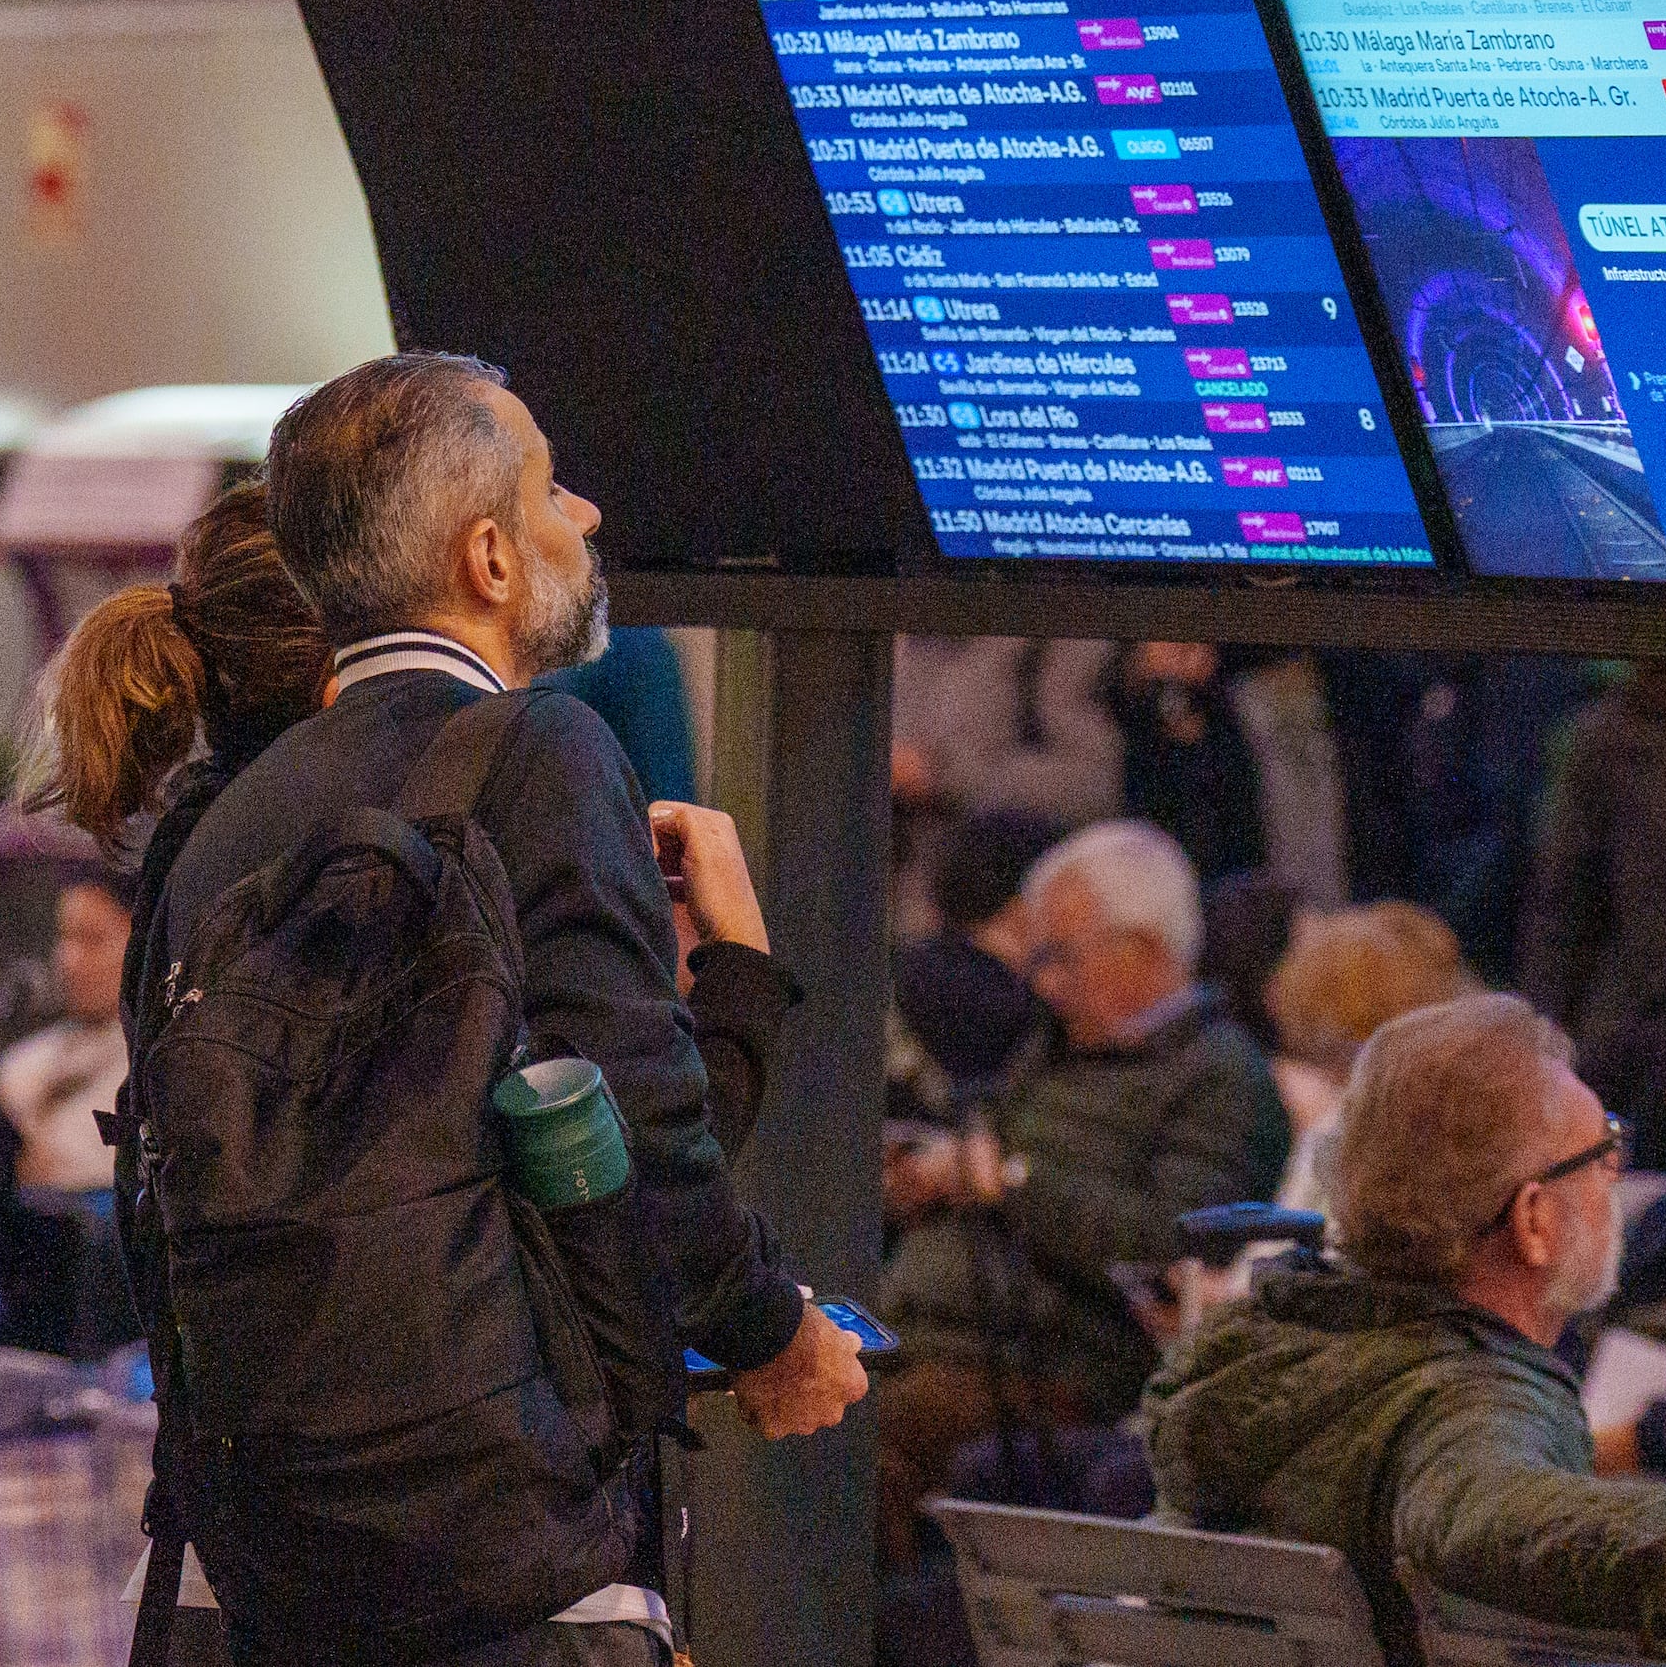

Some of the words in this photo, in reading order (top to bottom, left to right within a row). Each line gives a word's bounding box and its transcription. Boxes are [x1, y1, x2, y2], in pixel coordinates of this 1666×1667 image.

[1297, 30, 1349, 54] 10:30
[1351, 30, 1416, 55] Málaga
[1415, 30, 1466, 51] María
[1466, 29, 1555, 51] Zambrano
[791, 86, 841, 108] 10:33
[841, 84, 902, 106] Madrid
[900, 84, 959, 106] Puerta
[958, 82, 982, 105] de
[983, 80, 1087, 104] Atocha-A.G.
[1315, 87, 1368, 109] 10:33
[1370, 87, 1432, 108] Madrid
[1431, 86, 1490, 108] Puerta
[1492, 87, 1515, 107] de
[1519, 85, 1607, 107] Atocha-A.
[1608, 85, 1637, 106] Gr.
[1586, 211, 1648, 237] TÚNEL
